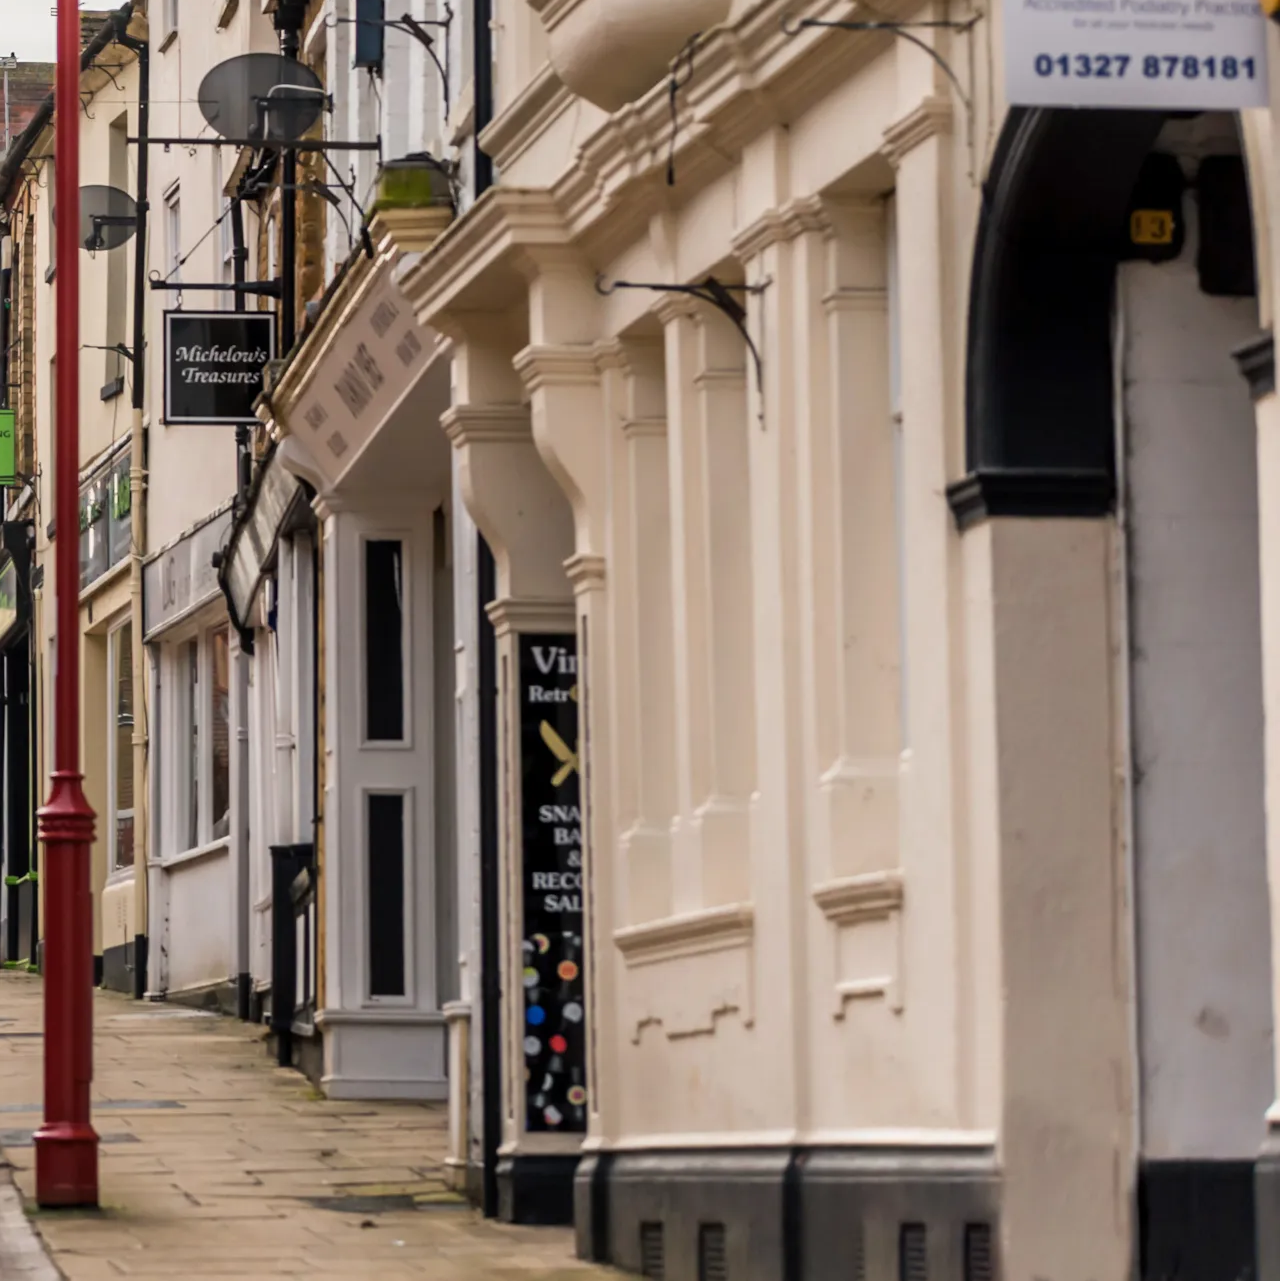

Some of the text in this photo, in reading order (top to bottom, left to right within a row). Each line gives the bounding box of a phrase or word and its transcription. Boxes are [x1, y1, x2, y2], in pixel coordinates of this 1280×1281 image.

[1034, 53, 1256, 80] 01327 878181
[175, 344, 268, 363] Michelow's
[181, 367, 260, 384] Treasures
